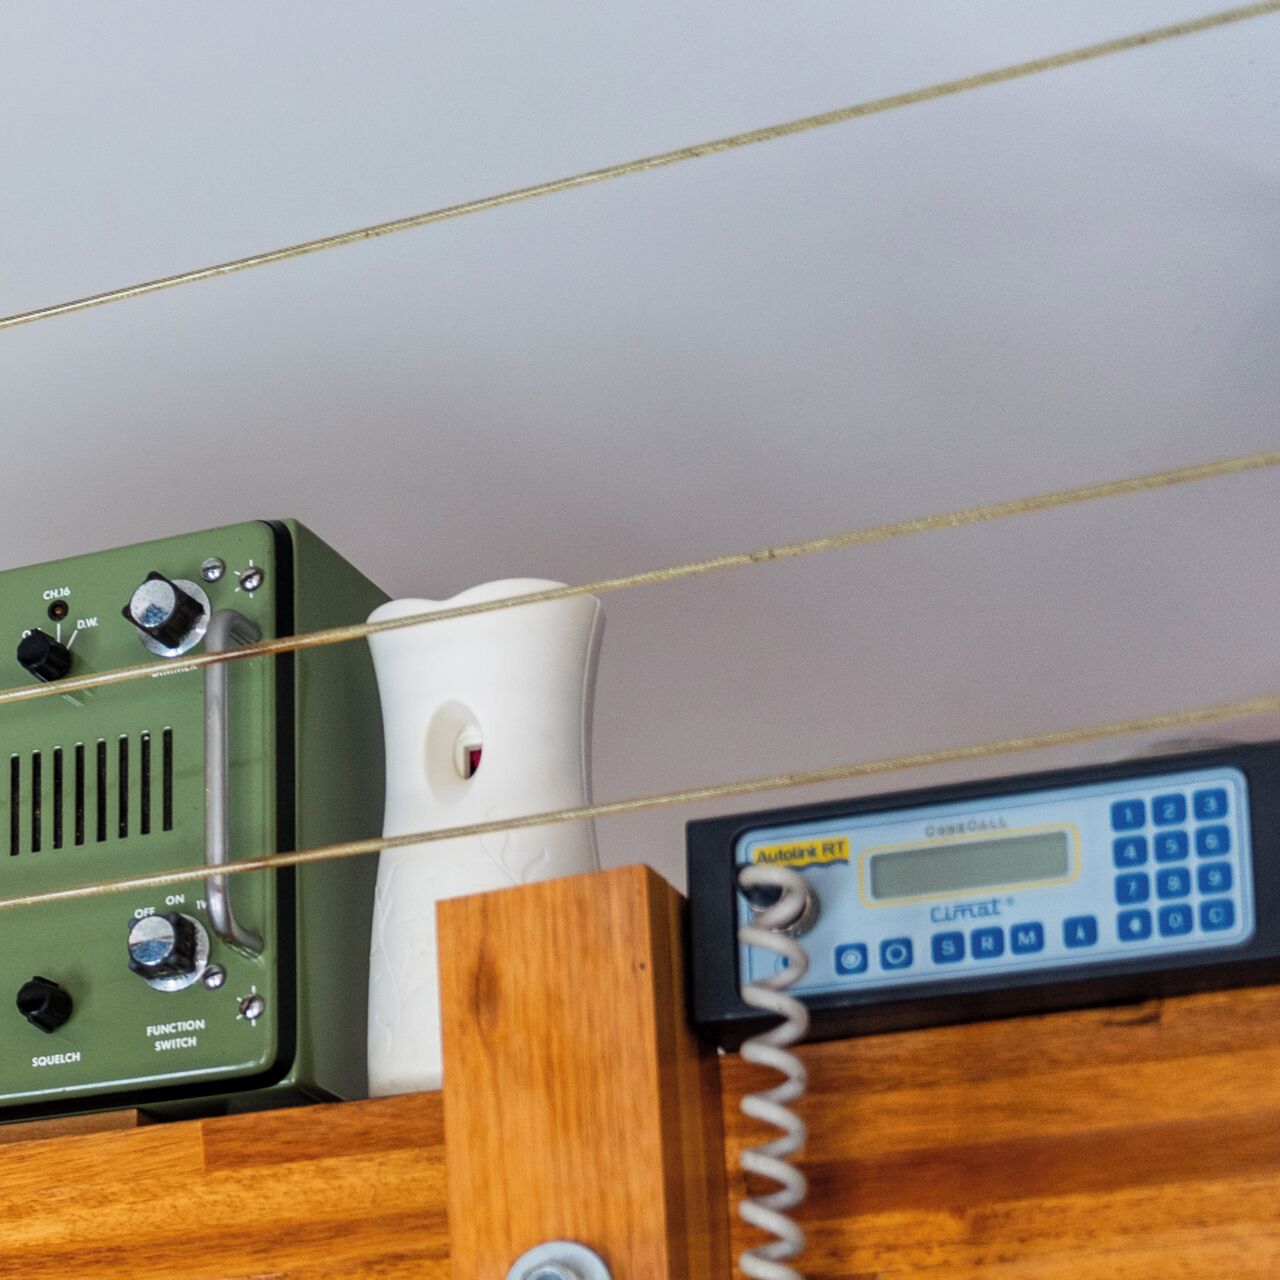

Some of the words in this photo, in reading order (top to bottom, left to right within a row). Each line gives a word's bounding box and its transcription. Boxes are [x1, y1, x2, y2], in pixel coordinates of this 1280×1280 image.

[42, 587, 70, 600] CH.16
[1124, 808, 1133, 823] 1
[1163, 803, 1176, 818] 2
[1203, 797, 1217, 813] 3
[822, 841, 845, 858] RT
[1123, 845, 1136, 860] 4
[1165, 839, 1178, 854] 5
[1127, 881, 1137, 897] 7
[1208, 871, 1222, 886] 9
[165, 894, 185, 905] ON
[134, 907, 155, 919] OFF
[1018, 930, 1035, 946] M
[146, 1019, 205, 1036] FUNCTION
[155, 1036, 197, 1051] SWITCH
[32, 1052, 81, 1067] SQUELCH
